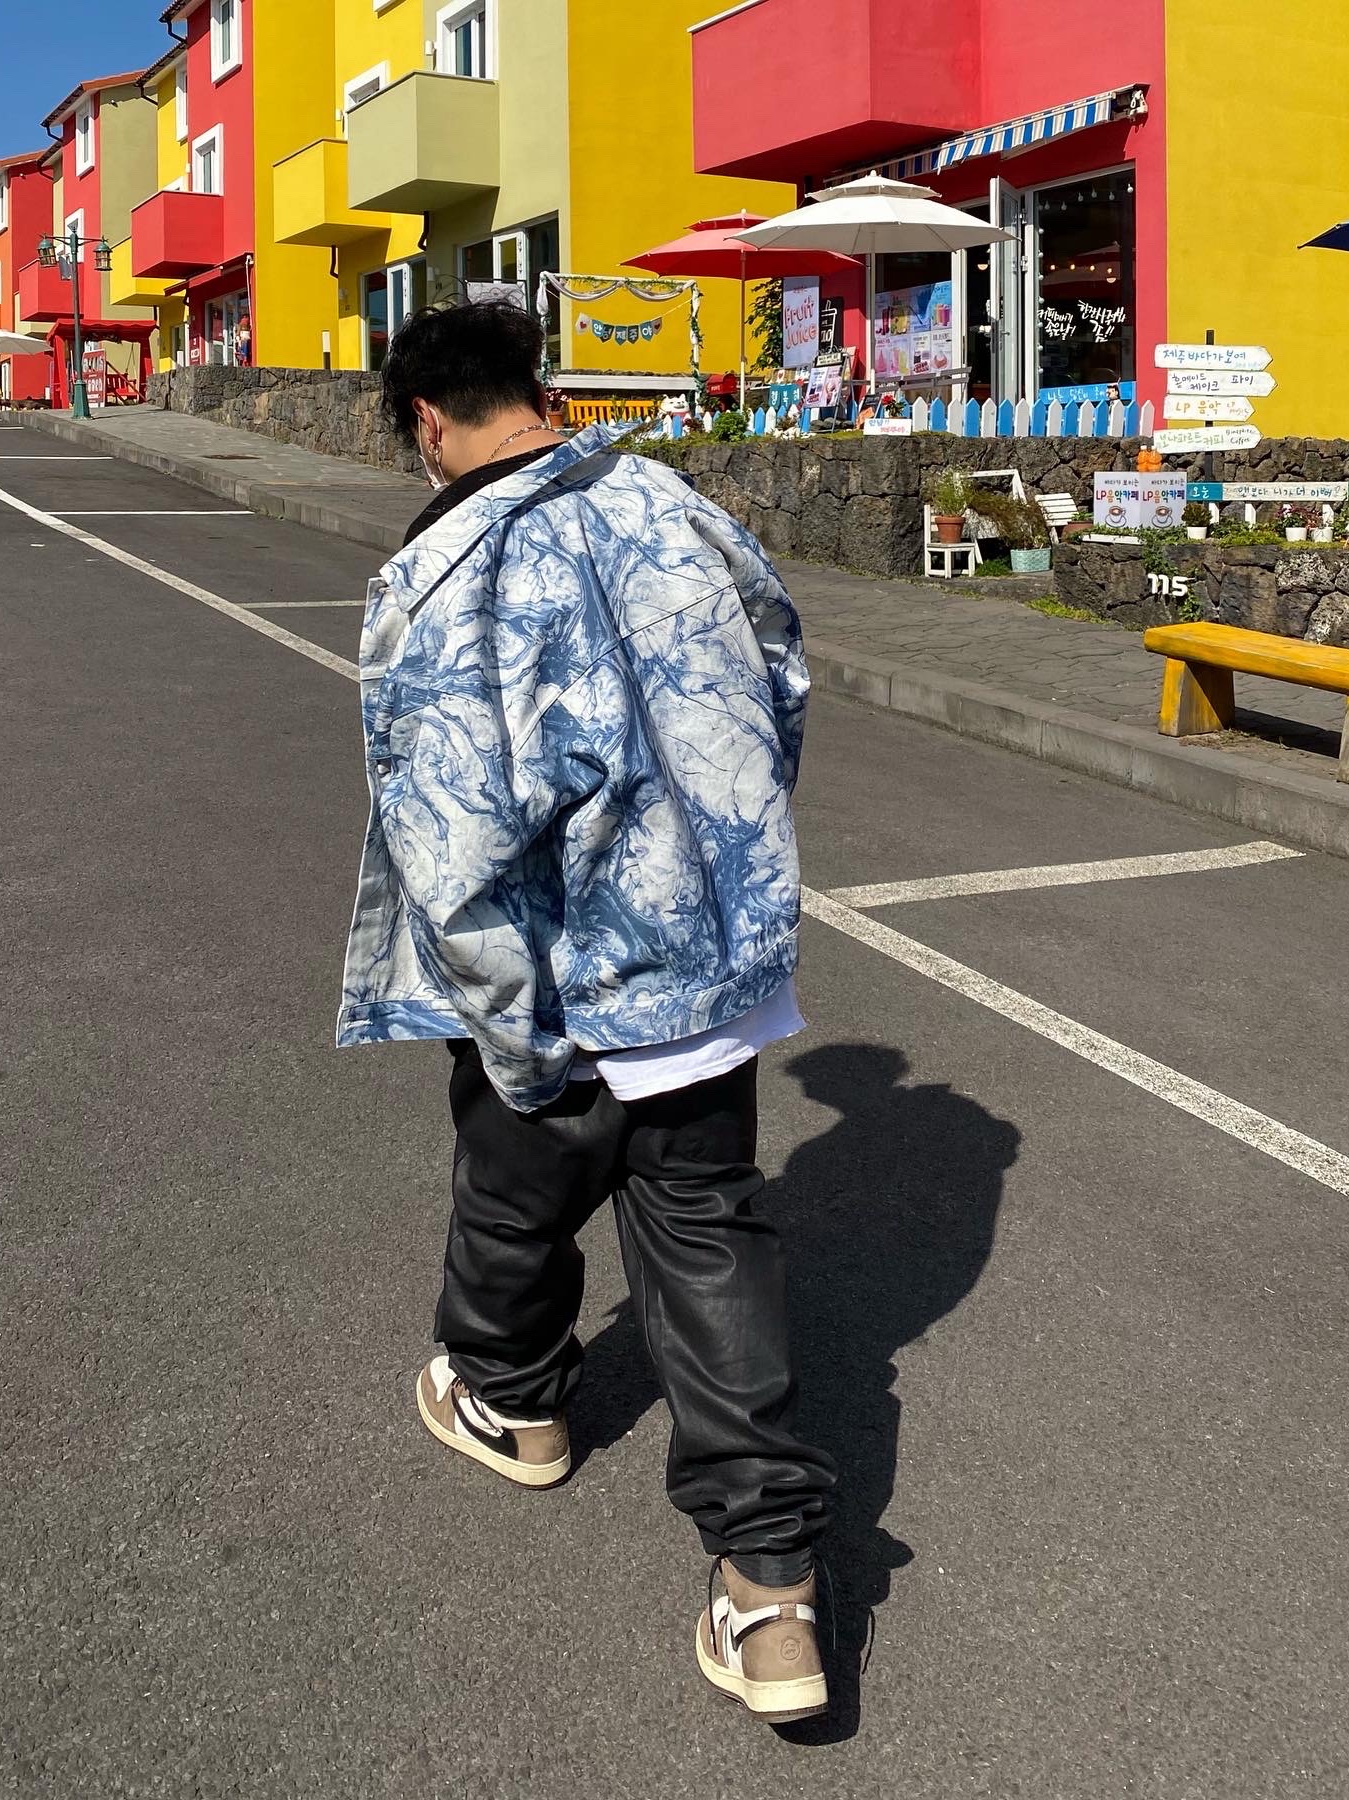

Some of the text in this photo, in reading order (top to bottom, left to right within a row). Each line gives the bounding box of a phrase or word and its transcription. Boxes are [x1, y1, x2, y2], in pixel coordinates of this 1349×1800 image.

[1175, 400, 1221, 414] LP 음악
[1096, 489, 1139, 503] LP음악카페
[1142, 489, 1185, 503] LP음악카페
[1193, 487, 1210, 498] 오늘
[1148, 573, 1189, 597] 115
